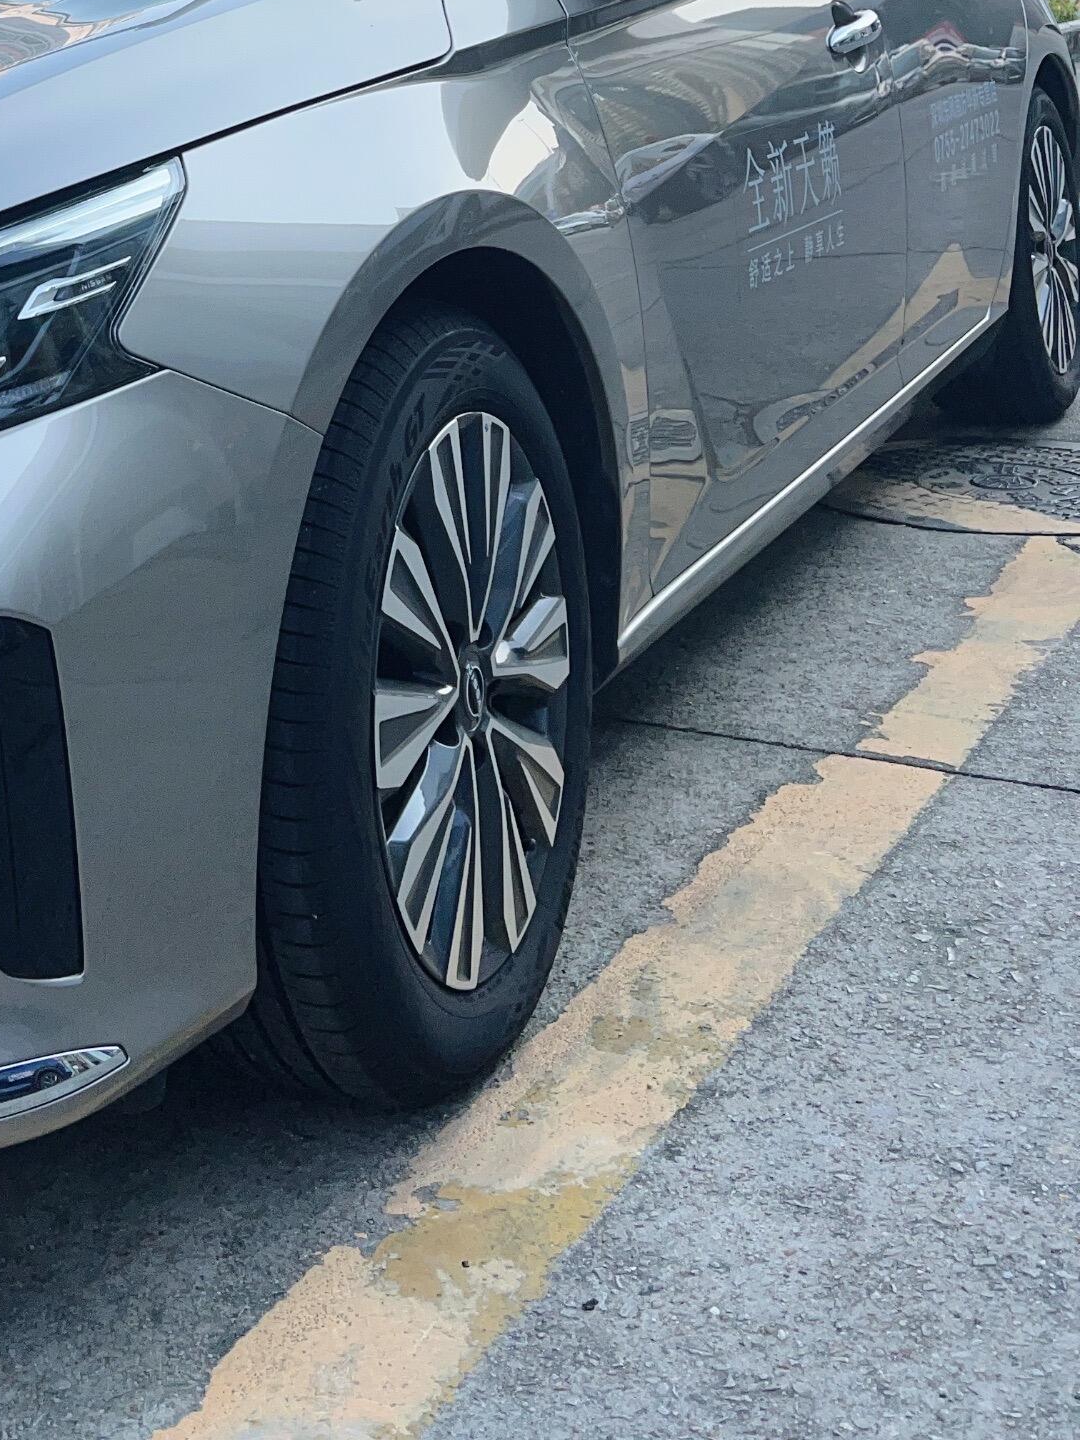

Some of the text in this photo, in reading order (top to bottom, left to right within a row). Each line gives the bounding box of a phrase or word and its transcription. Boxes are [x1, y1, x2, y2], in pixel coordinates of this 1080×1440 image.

[743, 120, 842, 234] 全新天籁
[749, 220, 845, 289] 舒适之上 静享人生
